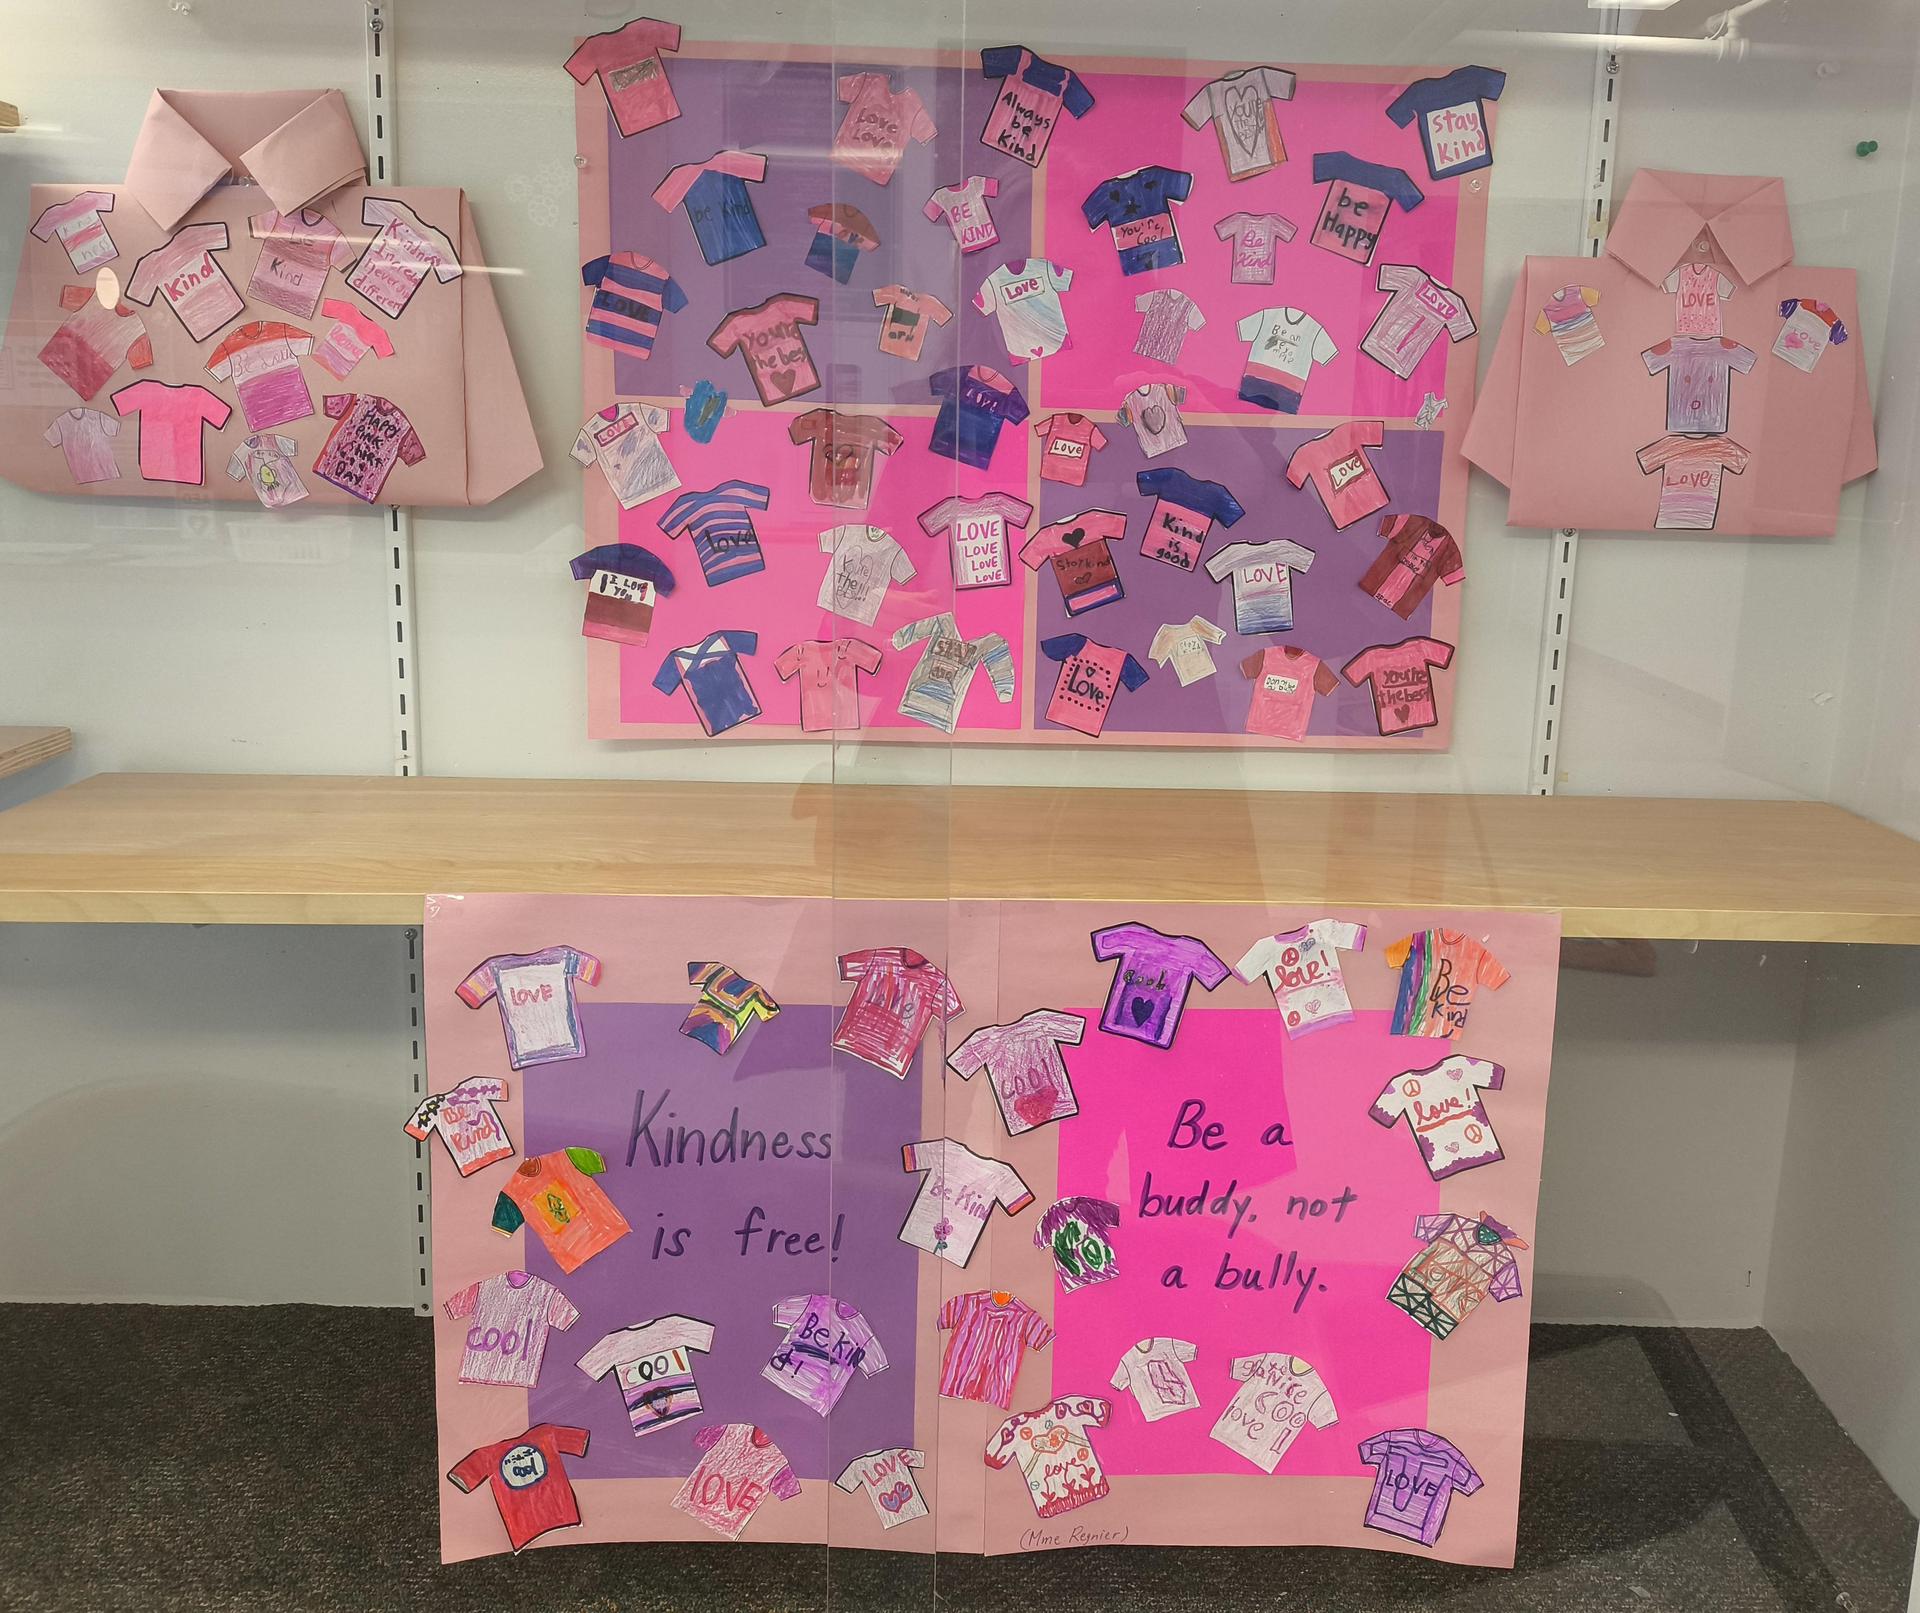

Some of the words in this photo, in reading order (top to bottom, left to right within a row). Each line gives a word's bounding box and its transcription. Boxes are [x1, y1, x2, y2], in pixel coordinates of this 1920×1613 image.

[1001, 91, 1051, 129] Always
[997, 129, 1037, 161] Kind
[951, 202, 973, 224] BE
[1337, 187, 1369, 217] be
[961, 222, 994, 245] KIND
[1321, 210, 1379, 250] Happy
[164, 252, 215, 303] Kind
[270, 256, 304, 287] Kind
[1005, 278, 1040, 300] Love
[1682, 292, 1716, 308] LOVE
[1053, 440, 1083, 456] Love
[956, 519, 1001, 543] LOVE
[1162, 512, 1204, 544] Kind
[964, 542, 999, 558] LOVE
[1155, 547, 1191, 569] good
[1167, 537, 1181, 552] is
[971, 560, 999, 572] LOVE
[975, 570, 1003, 584] LOVE
[1243, 562, 1288, 585] LOVE
[1067, 664, 1105, 705] Love
[510, 983, 553, 1007] LOVE
[1430, 958, 1471, 1004] Be
[625, 1088, 832, 1167] Kindness
[1167, 1098, 1228, 1151] Be
[1260, 1122, 1294, 1146] a
[1286, 1186, 1358, 1223] not
[651, 1212, 692, 1260] is
[734, 1206, 846, 1263] free!
[1160, 1265, 1188, 1289] a
[1214, 1251, 1328, 1314] bully.
[799, 1312, 831, 1348] Be
[862, 1449, 915, 1487] LOVE
[1385, 1469, 1438, 1497] LOVE
